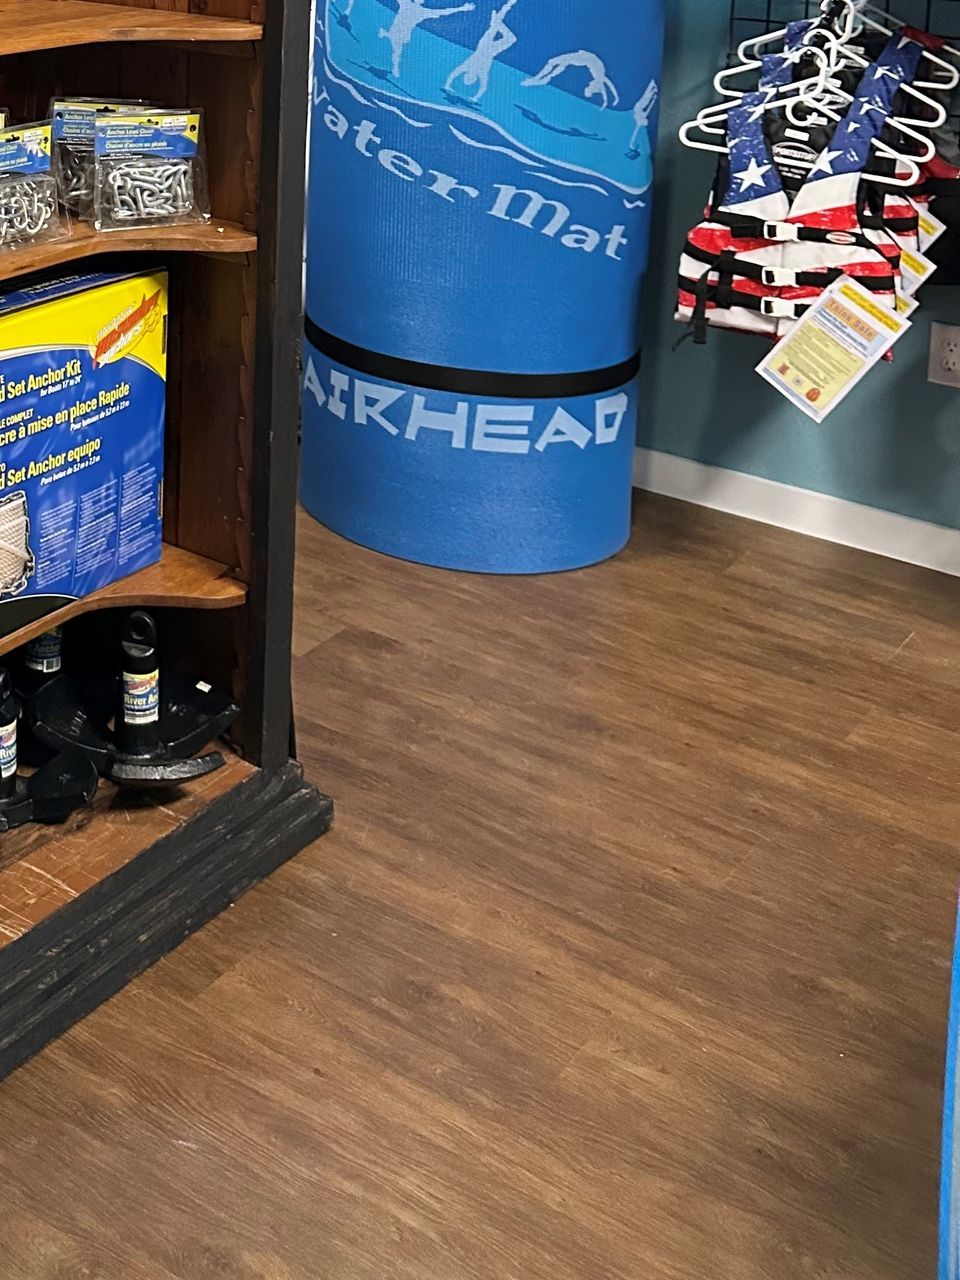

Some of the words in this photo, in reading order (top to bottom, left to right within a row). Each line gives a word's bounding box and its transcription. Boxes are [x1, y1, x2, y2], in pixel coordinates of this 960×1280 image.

[487, 183, 628, 261] Mat
[7, 380, 27, 400] Set
[27, 366, 66, 393] Anchor
[66, 359, 82, 378] Kit
[303, 356, 628, 455] AIRHEAD
[6, 408, 34, 427] COMPLET
[18, 422, 26, 439] à
[28, 416, 53, 435] mise
[55, 409, 68, 424] en
[69, 397, 98, 423] place
[98, 383, 130, 408] Rapide
[7, 465, 26, 487] Set
[28, 451, 66, 479] Anchor
[67, 437, 101, 461] equipo
